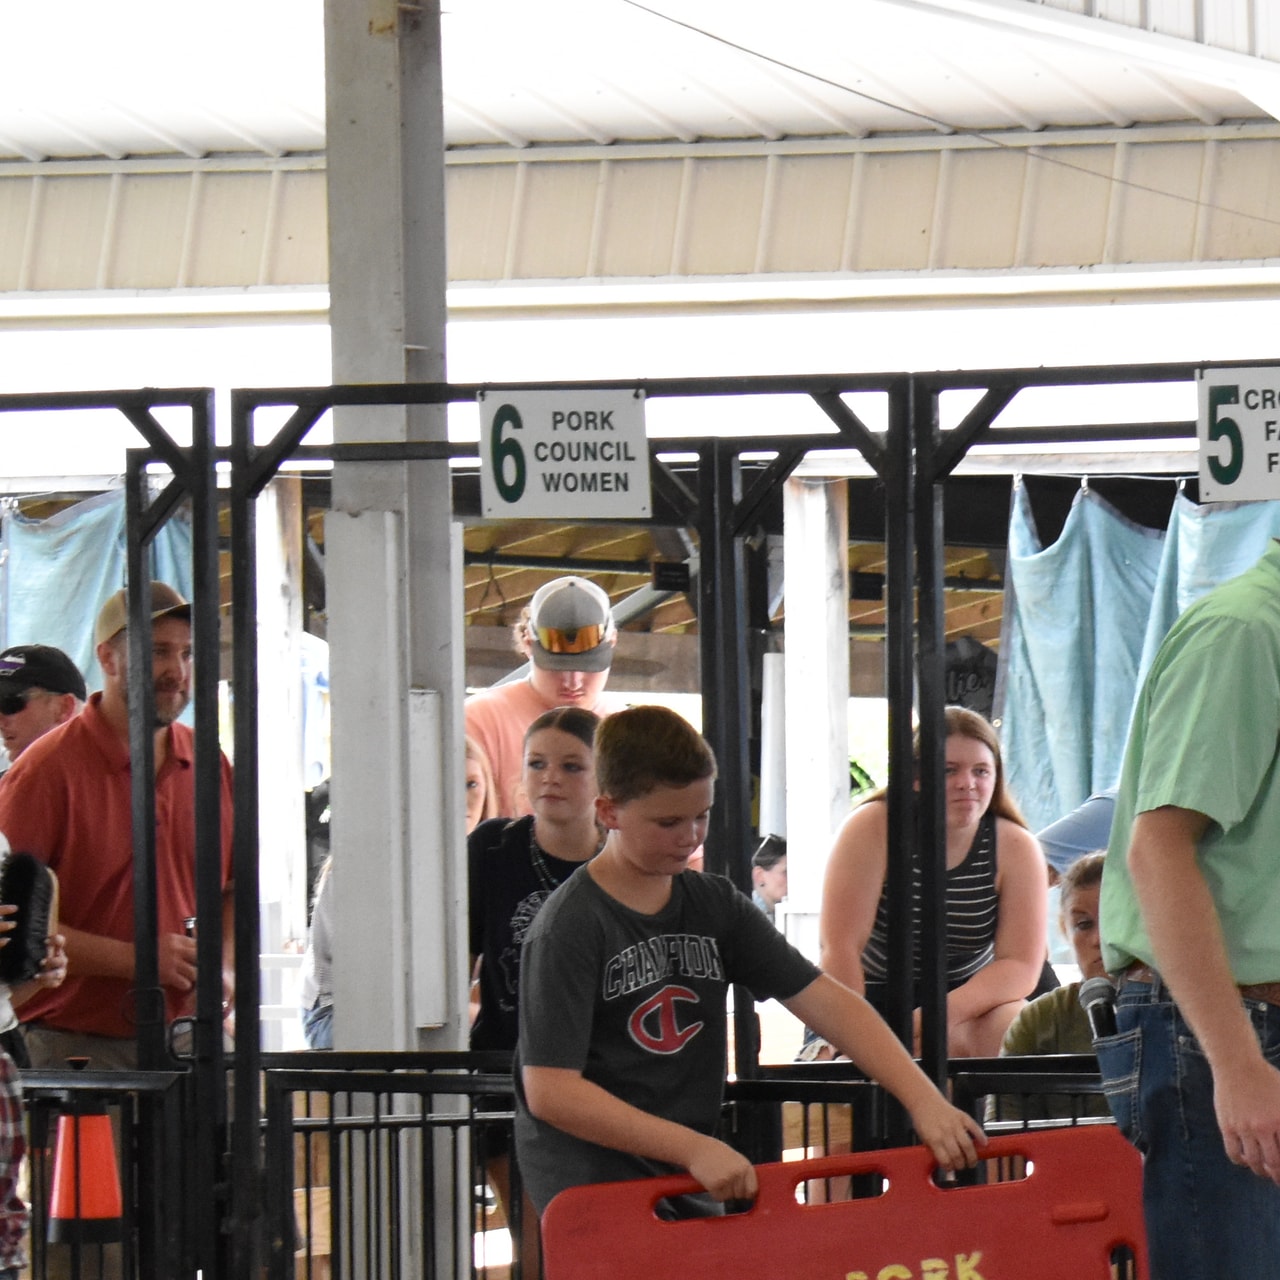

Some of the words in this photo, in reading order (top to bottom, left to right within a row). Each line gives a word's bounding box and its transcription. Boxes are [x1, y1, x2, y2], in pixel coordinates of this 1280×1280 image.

[552, 411, 615, 431] PORK
[1207, 384, 1244, 485] 5
[490, 404, 527, 503] 6
[534, 441, 636, 462] COUNCIL
[542, 472, 630, 492] WOMEN
